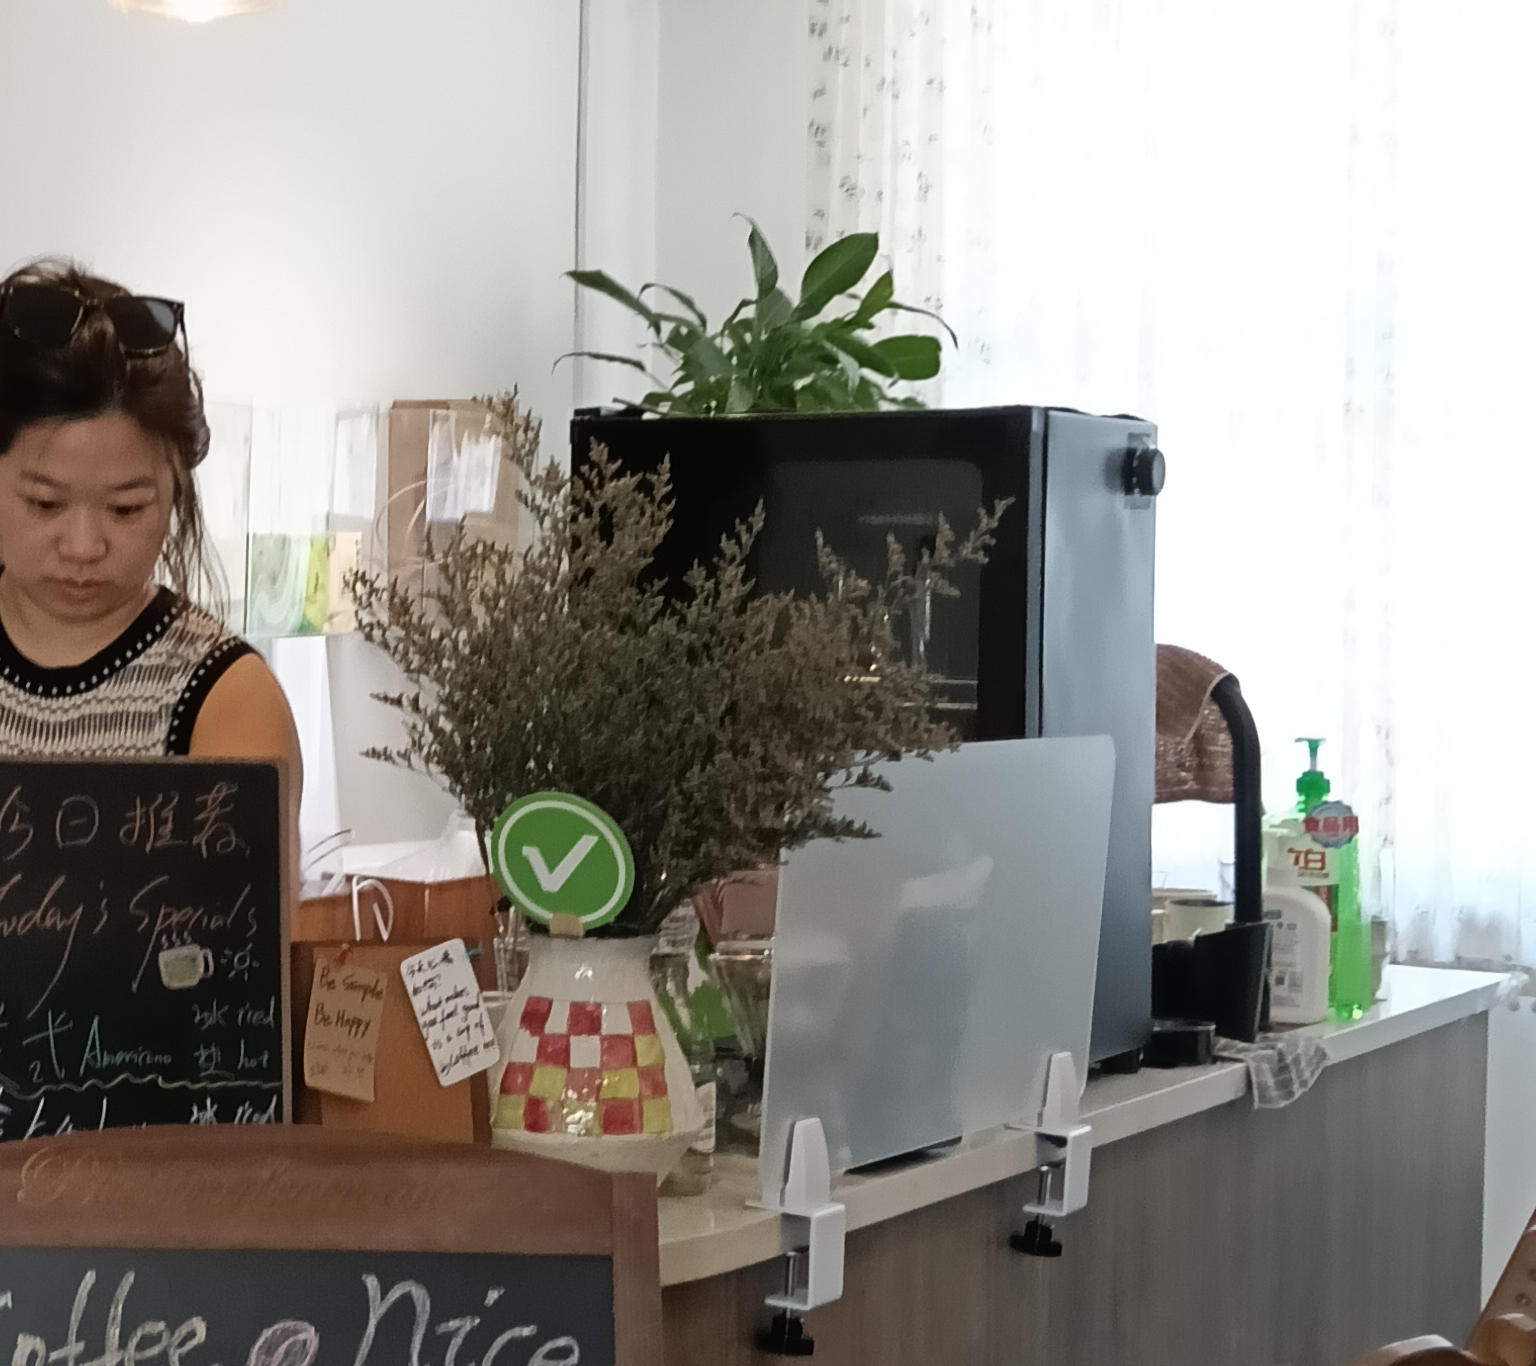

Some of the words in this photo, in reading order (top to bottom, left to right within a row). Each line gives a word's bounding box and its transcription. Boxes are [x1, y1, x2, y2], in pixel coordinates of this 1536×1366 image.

[319, 965, 337, 992] Be
[314, 1001, 332, 1028] Be
[336, 1008, 371, 1039] Happy
